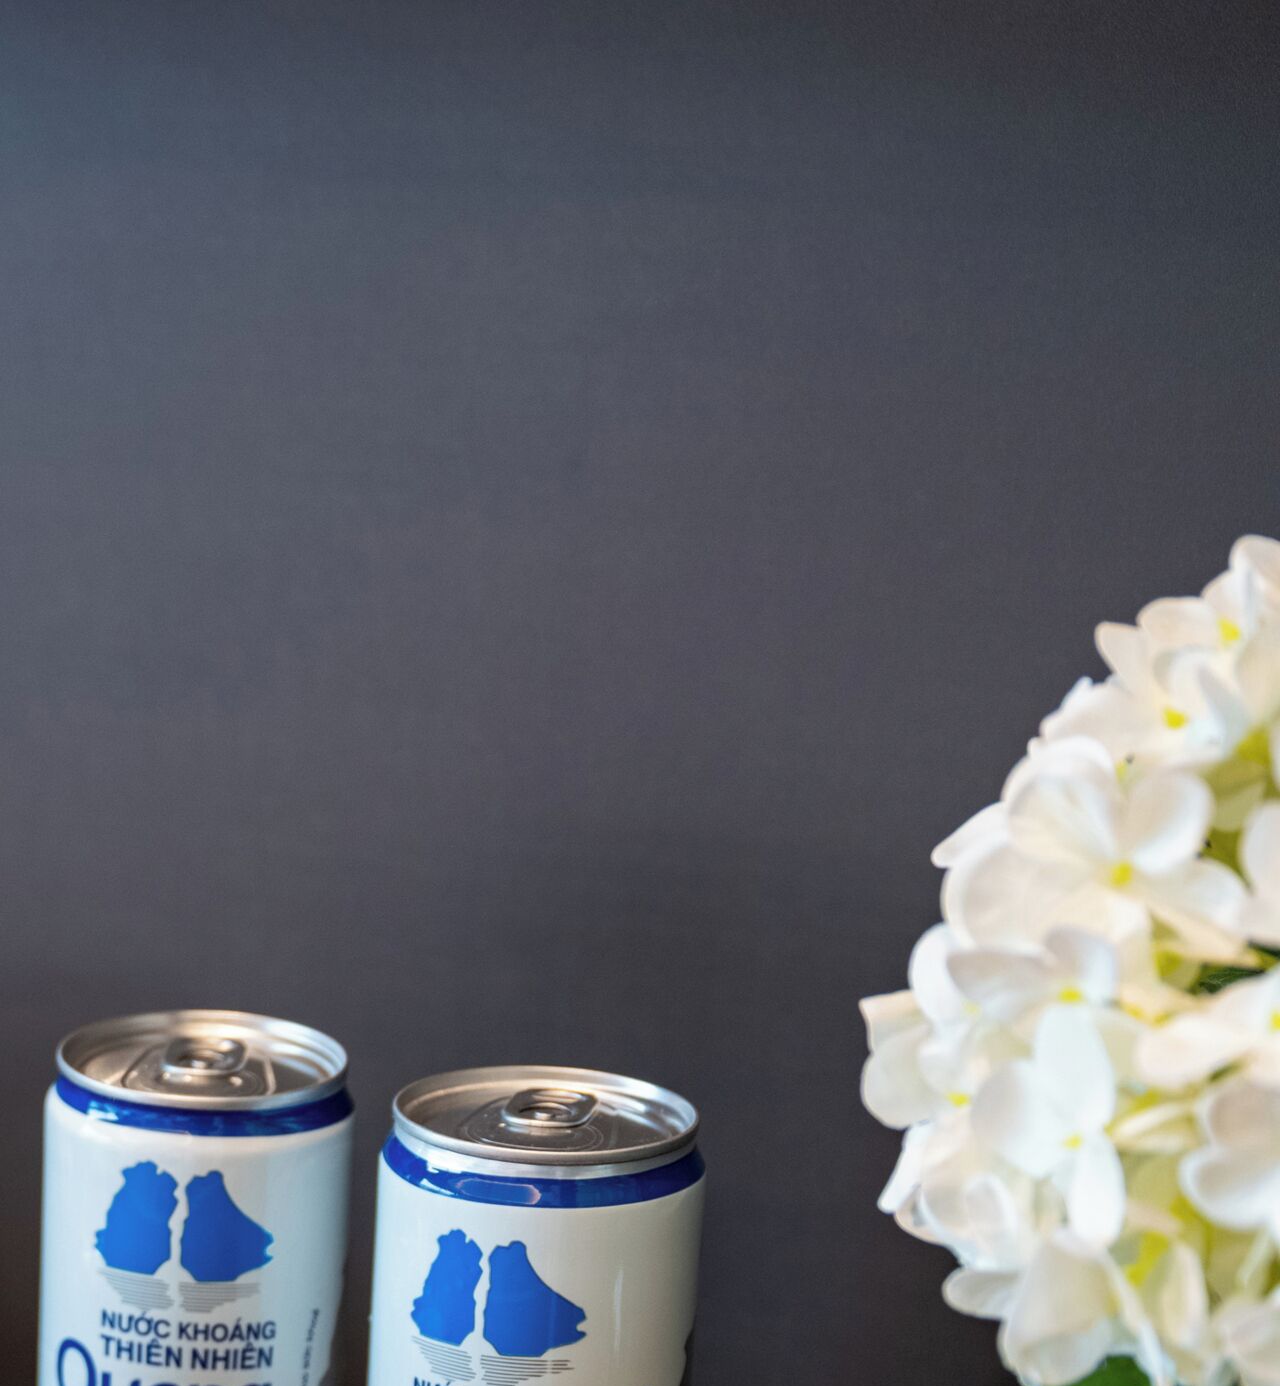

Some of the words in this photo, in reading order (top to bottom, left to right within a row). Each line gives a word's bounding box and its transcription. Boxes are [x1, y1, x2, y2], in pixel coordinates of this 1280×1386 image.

[101, 1309, 170, 1338] NƯỚC
[178, 1317, 276, 1342] KHOÁNG
[101, 1335, 182, 1368] THIÊN
[191, 1344, 273, 1370] NHIÊN
